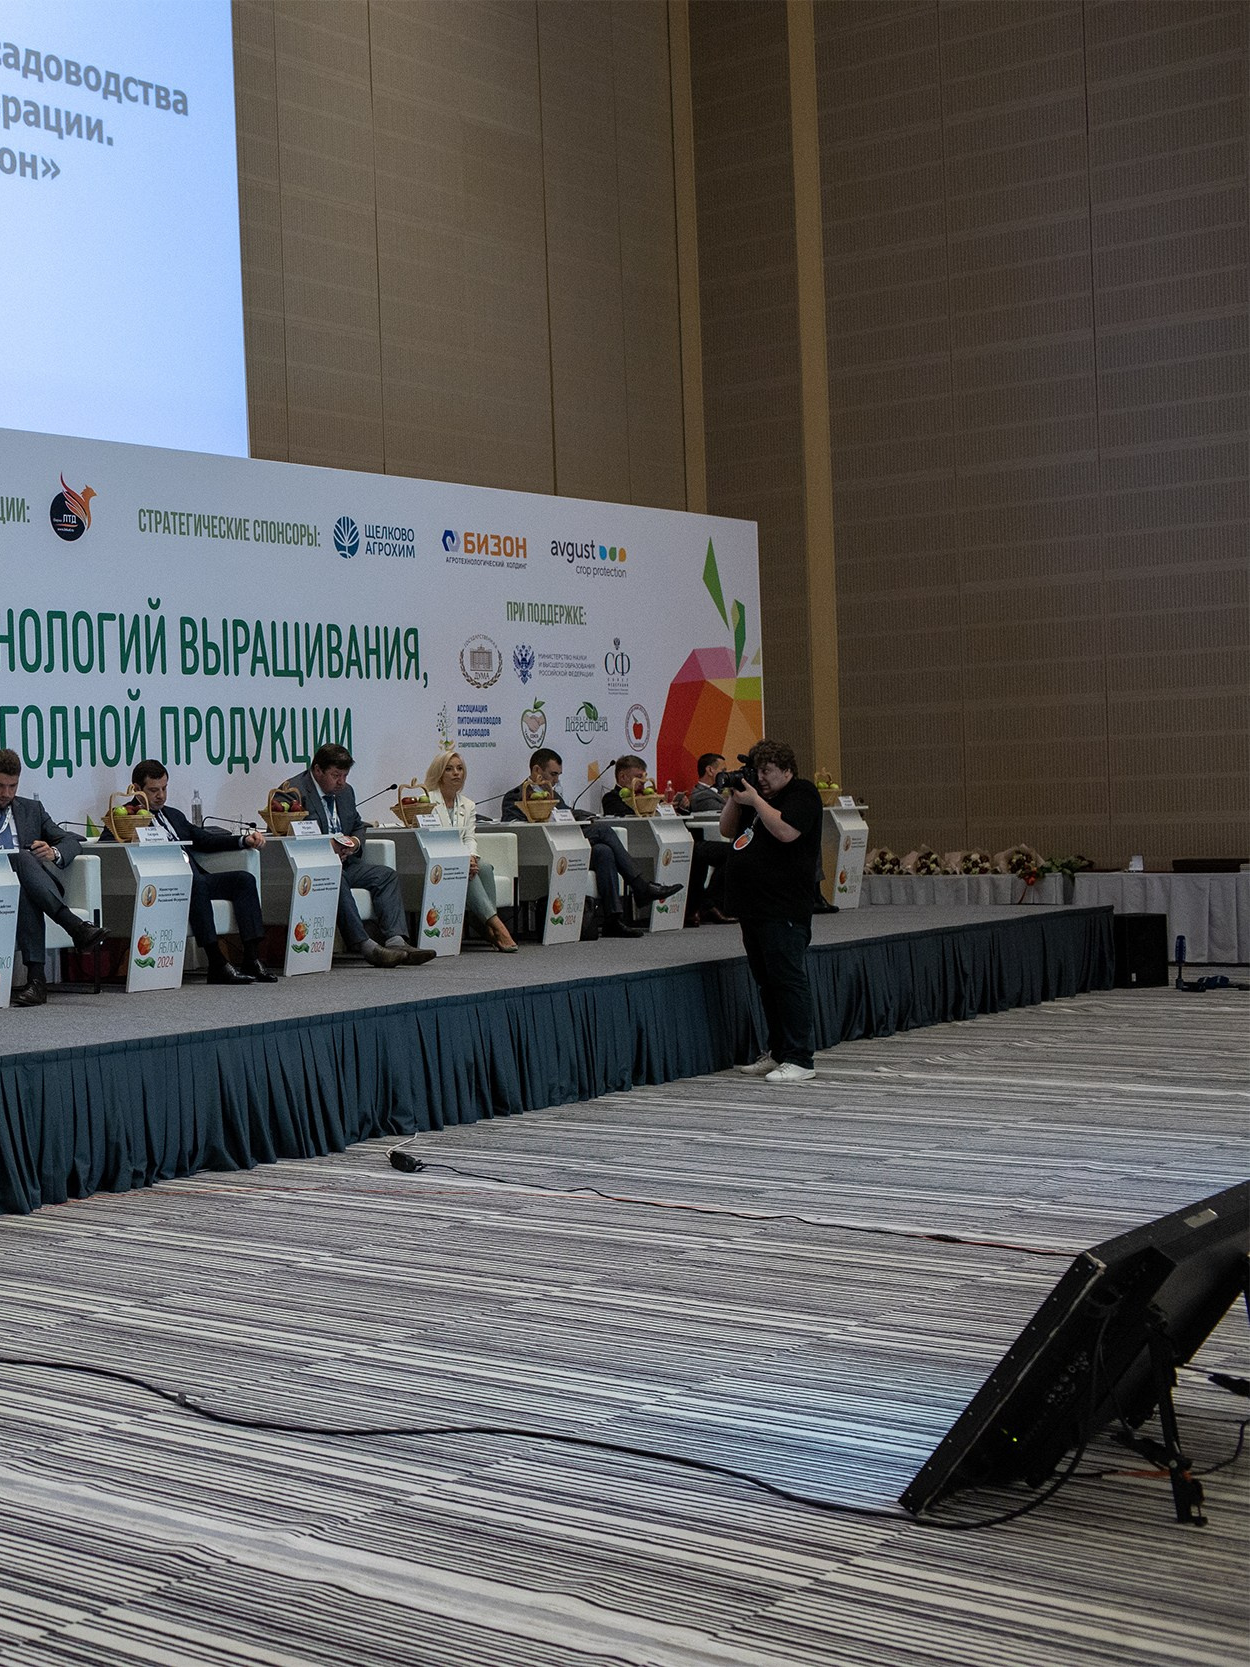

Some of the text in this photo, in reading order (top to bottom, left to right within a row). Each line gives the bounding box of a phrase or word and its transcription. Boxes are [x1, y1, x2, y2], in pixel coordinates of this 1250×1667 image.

[137, 508, 322, 548] СТРАТЕГИЧЕСКИЕ СПОНСОРЫ:
[364, 524, 415, 542] ЩЕЛКОВО
[365, 541, 416, 559] АГРОХИМ
[463, 531, 528, 559] БИЗОН
[550, 540, 596, 563] avgust
[575, 564, 627, 578] crop protection
[506, 601, 587, 626] ПРИ ПОДДЕРЖКЕ:
[178, 616, 430, 689] ВЫРАЩИВАНИЯ,
[604, 652, 631, 676] СФ
[456, 704, 488, 713] АССОЦИАЦИЯ
[565, 716, 609, 732] Дагестана
[160, 706, 354, 780] ПРОДУКЦИИ
[160, 929, 173, 941] PRO
[441, 927, 455, 938] 2024
[158, 940, 184, 954] ЯБЛОКО
[310, 941, 326, 953] 2024
[157, 956, 174, 969] 2024
